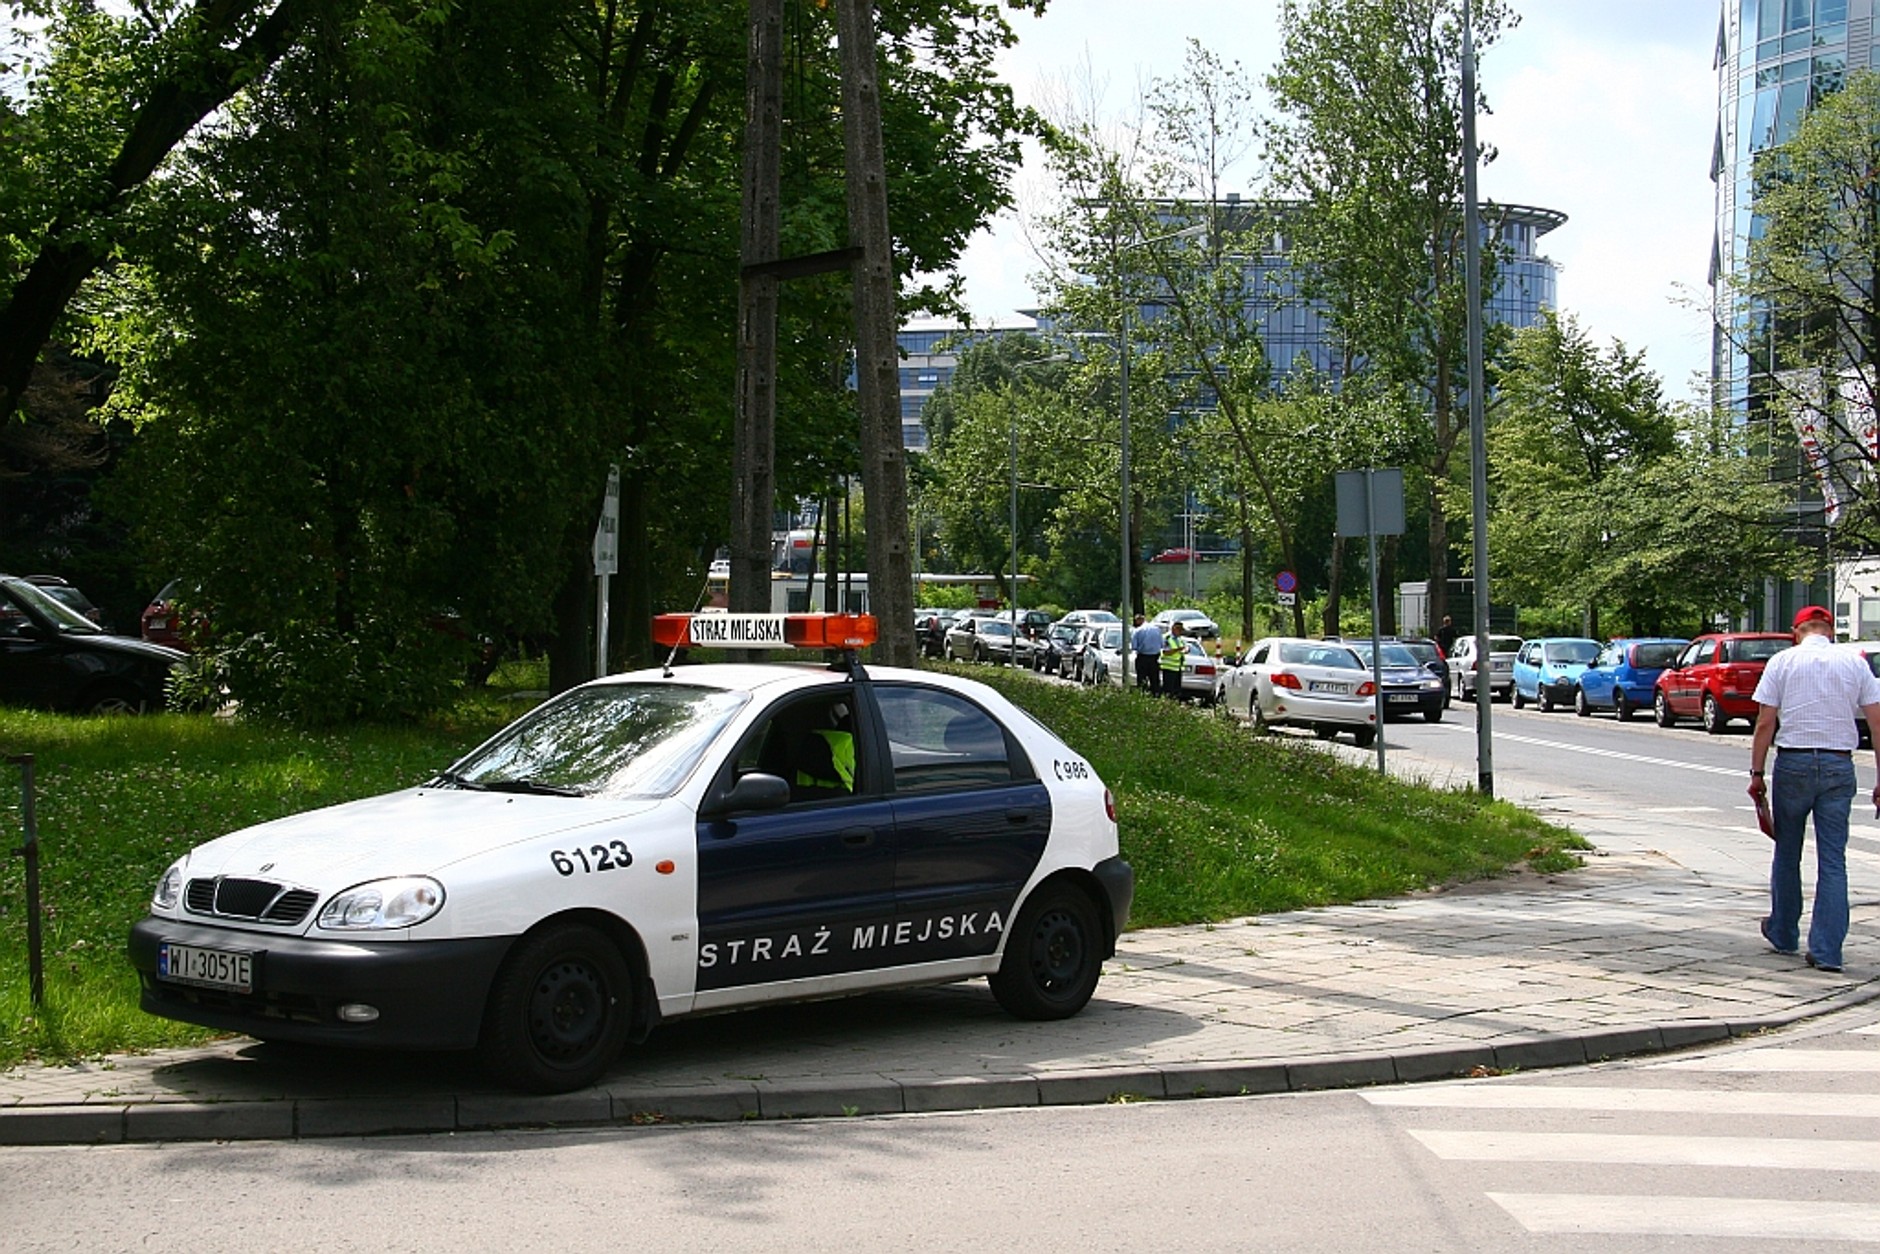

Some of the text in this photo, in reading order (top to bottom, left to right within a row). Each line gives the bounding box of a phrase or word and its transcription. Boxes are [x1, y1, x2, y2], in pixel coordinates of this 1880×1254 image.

[731, 619, 782, 641] MIEJSKA
[1063, 761, 1089, 780] 986
[550, 840, 633, 877] 6123
[699, 910, 1004, 968] STRAŻ MIEJSKA
[198, 951, 250, 984] 3051E
